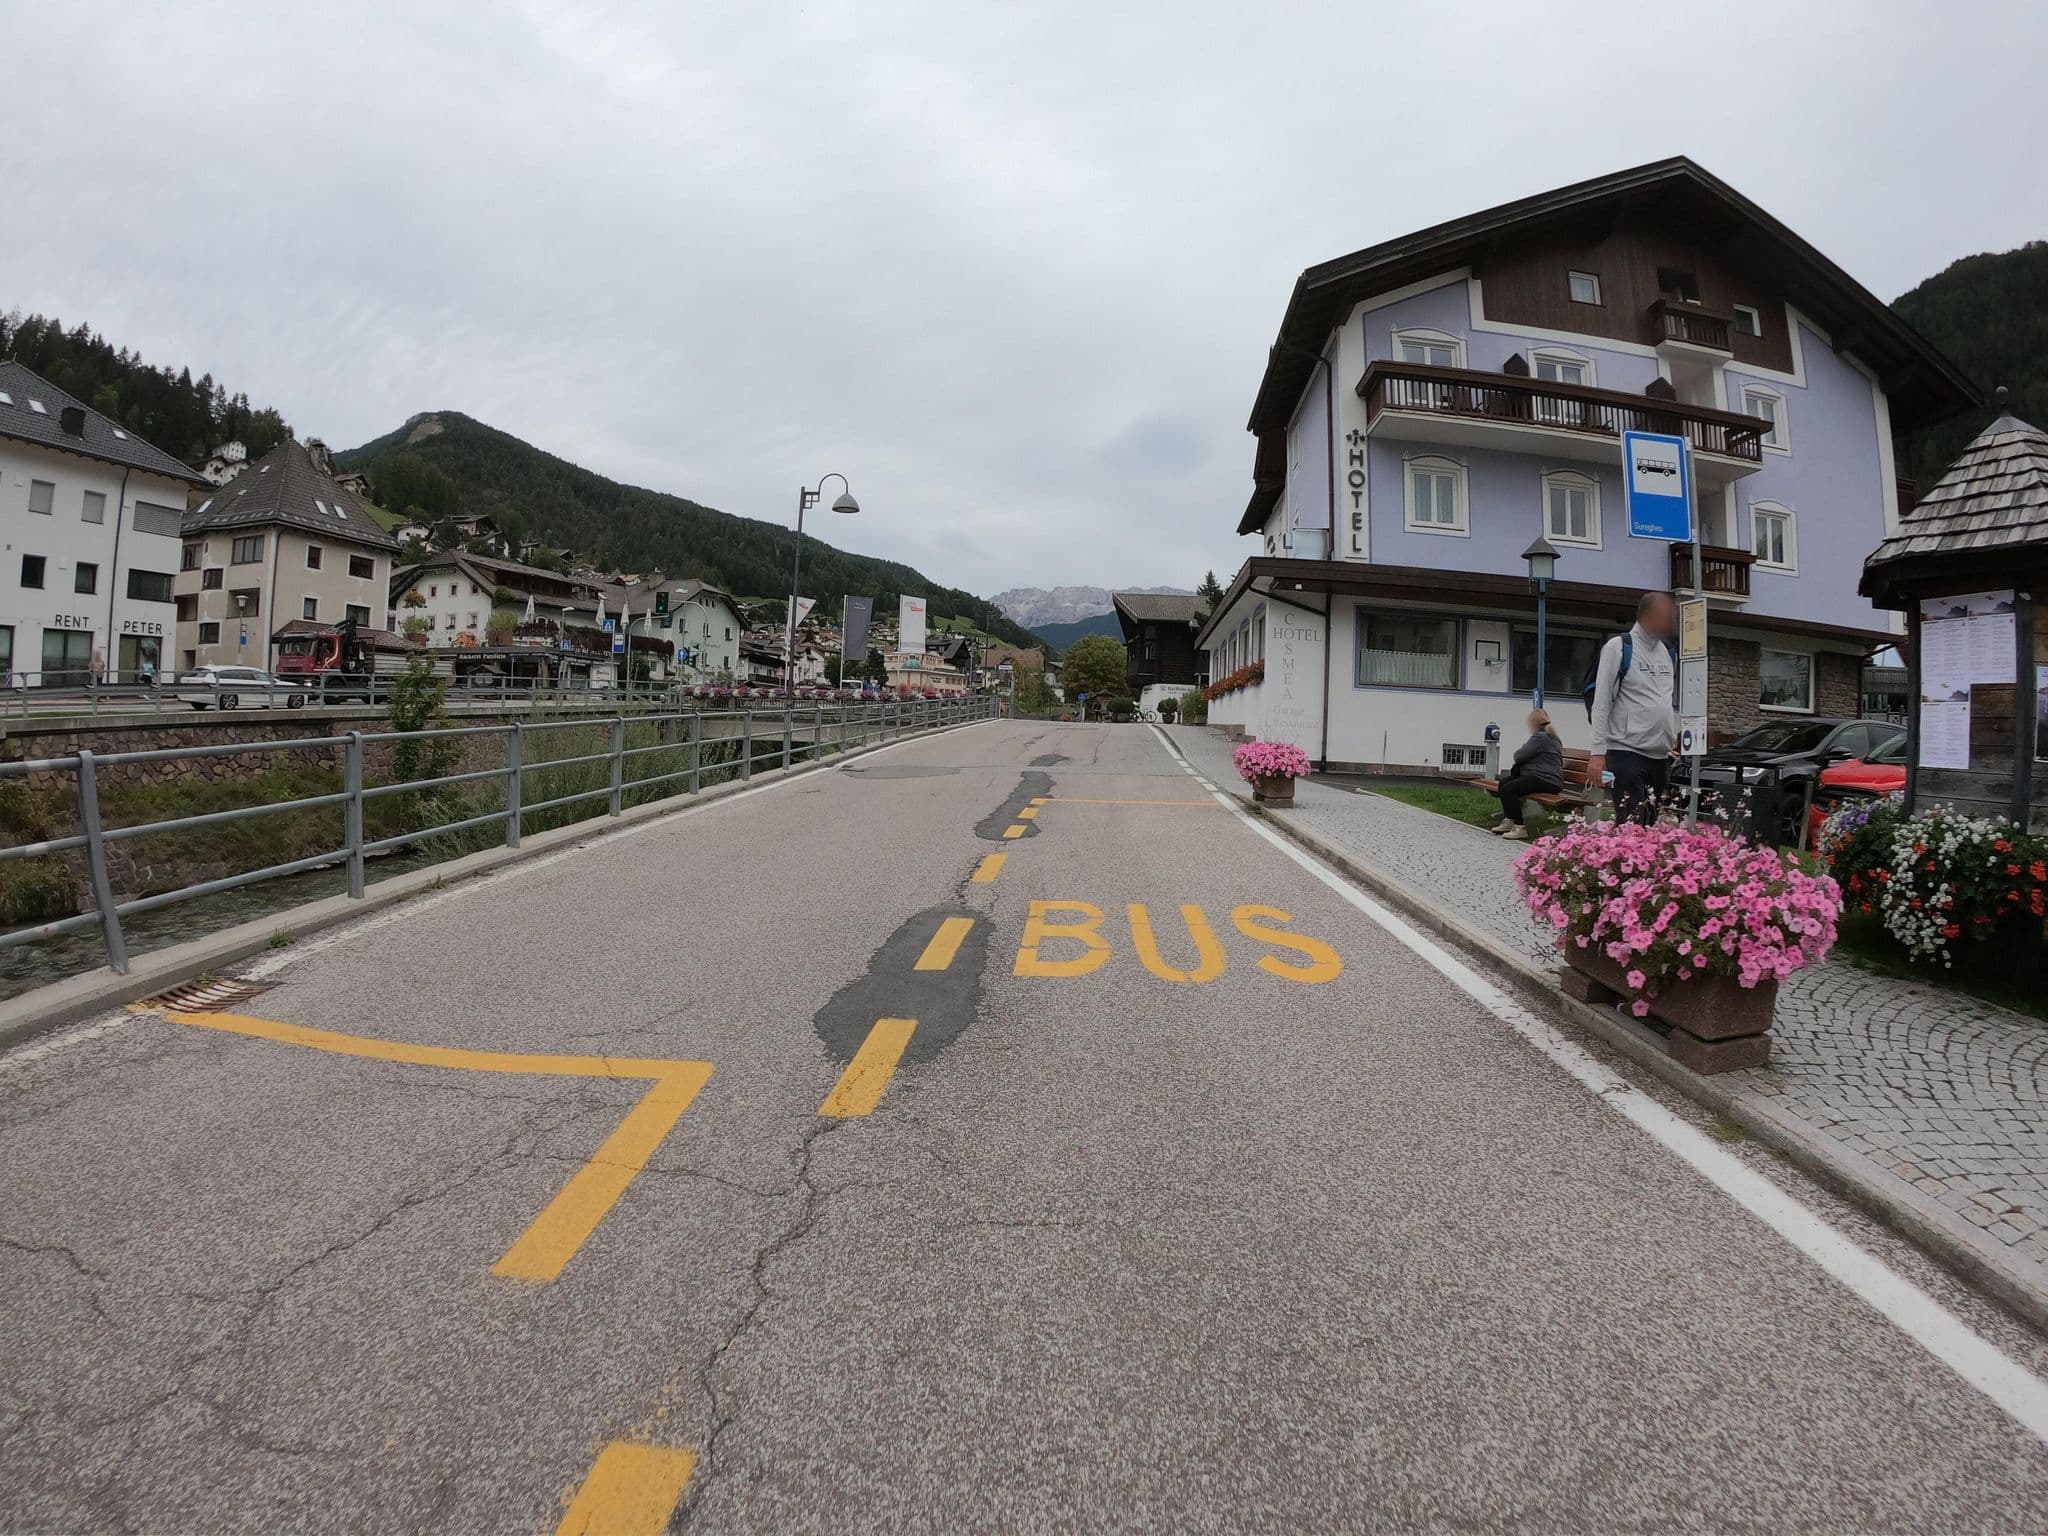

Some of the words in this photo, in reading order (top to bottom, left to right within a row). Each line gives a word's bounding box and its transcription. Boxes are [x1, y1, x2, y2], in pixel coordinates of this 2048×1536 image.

[1348, 448, 1366, 553] HOTEL
[55, 614, 90, 629] RENT
[123, 620, 163, 635] PETER
[1273, 627, 1321, 642] HOTEL
[1013, 899, 1344, 984] BUS
